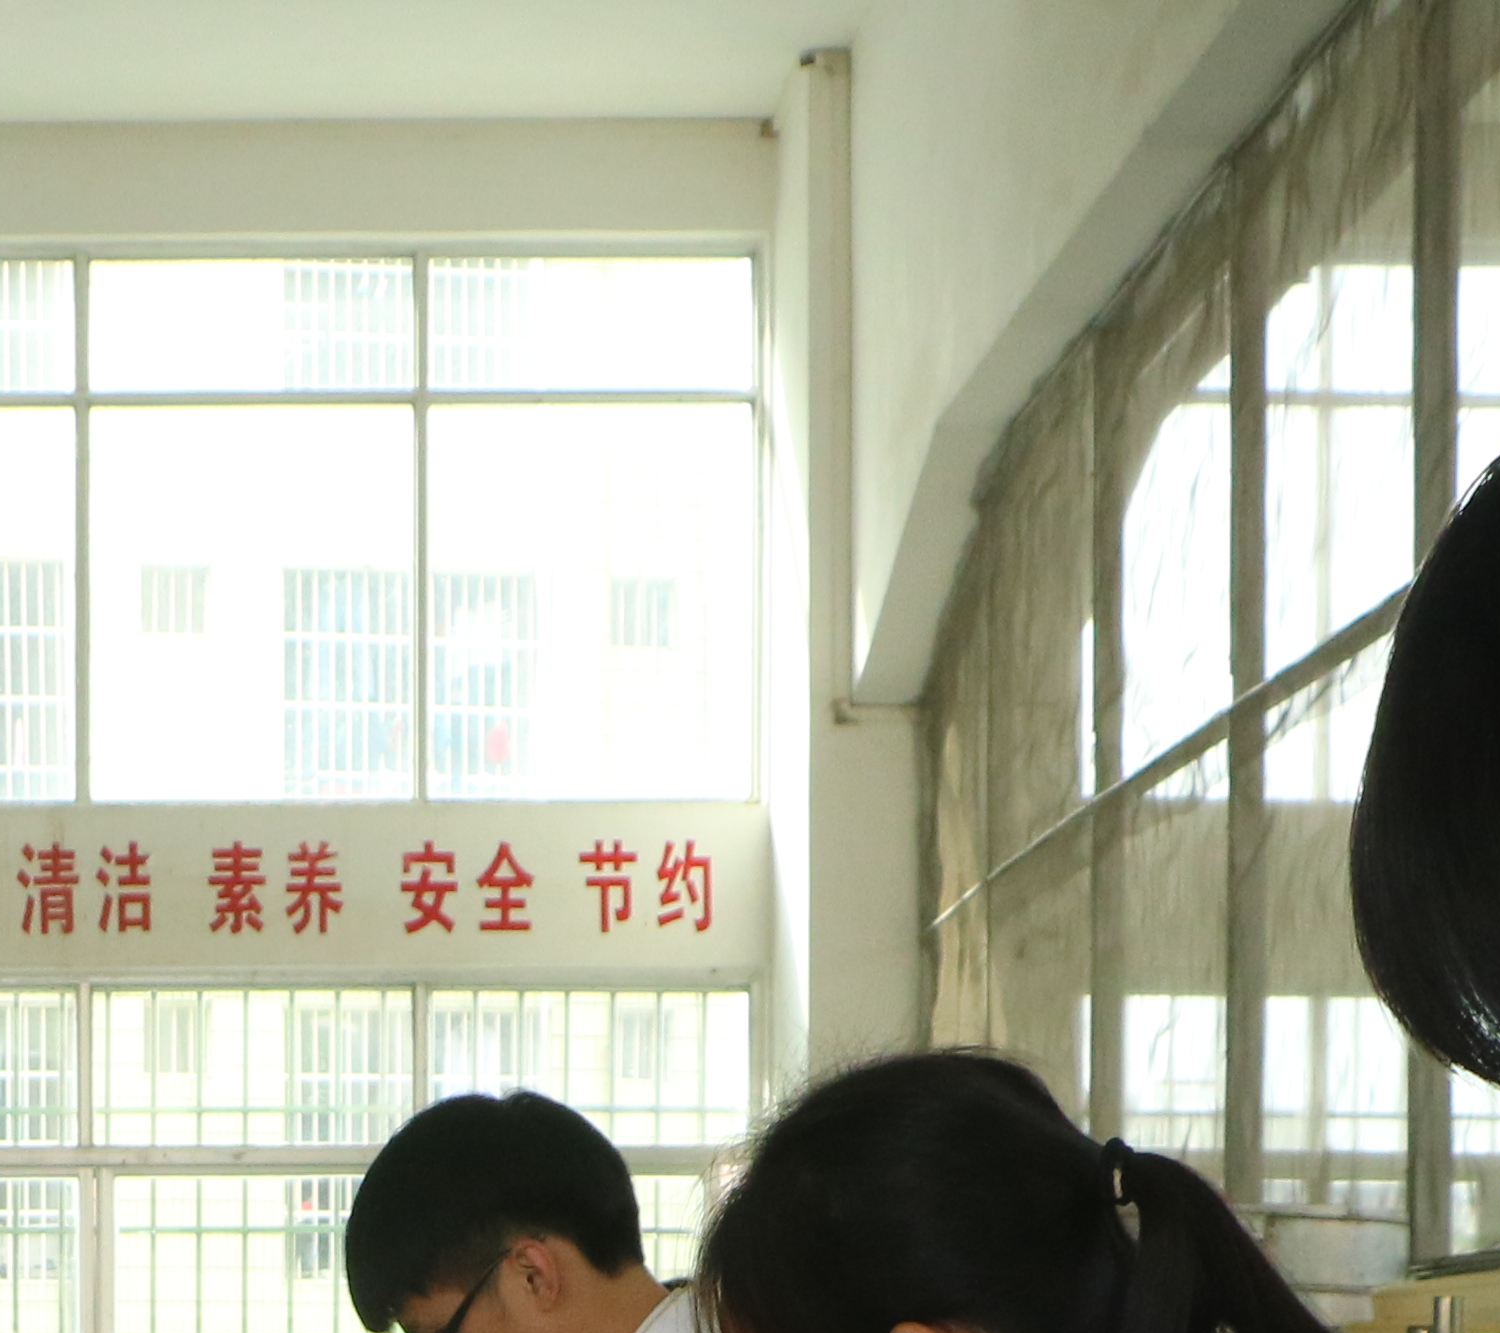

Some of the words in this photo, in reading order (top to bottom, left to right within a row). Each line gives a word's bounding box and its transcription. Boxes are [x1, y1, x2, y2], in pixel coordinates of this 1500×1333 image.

[18, 842, 151, 934] 清洁
[209, 842, 343, 934] 素养
[400, 841, 534, 933] 安全
[579, 840, 712, 932] 节约
